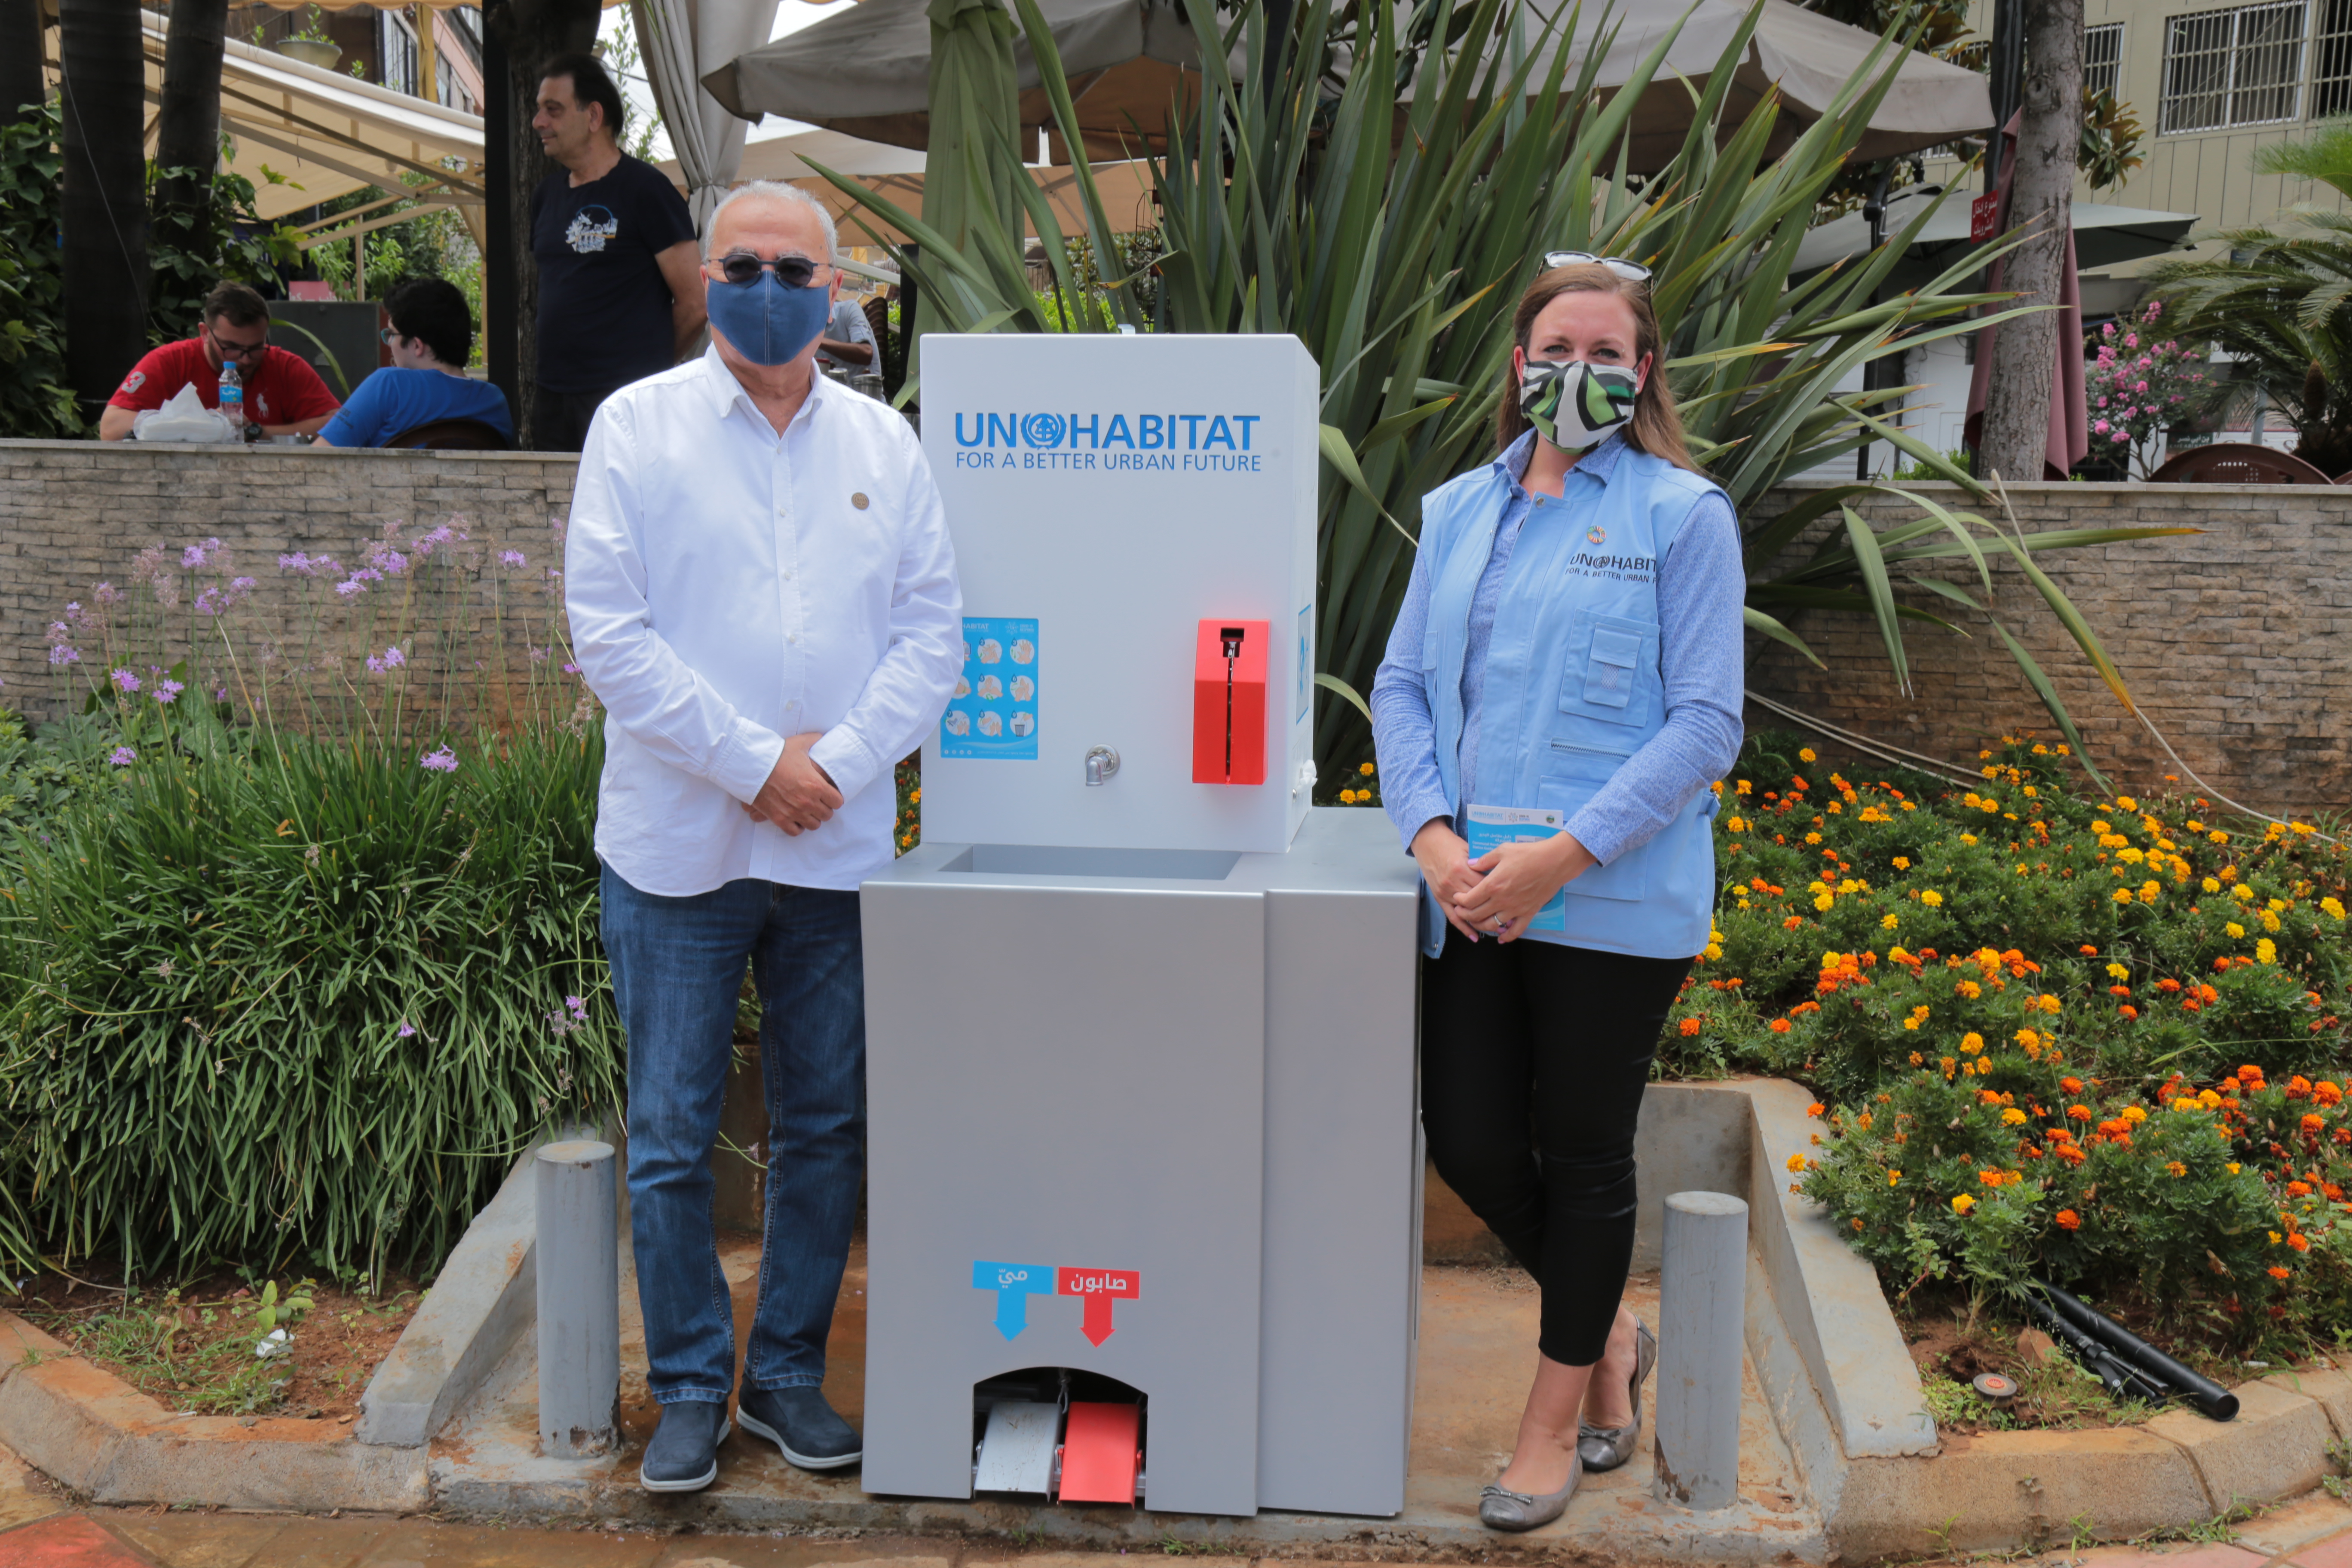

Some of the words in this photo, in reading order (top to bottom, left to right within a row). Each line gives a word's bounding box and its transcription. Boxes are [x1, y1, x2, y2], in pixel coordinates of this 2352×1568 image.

[122, 371, 146, 393] 3
[956, 452, 995, 469] FOR
[1001, 452, 1016, 469] A
[1024, 453, 1096, 469] BETTER
[1104, 453, 1175, 470] URBAN
[1183, 454, 1261, 472] FUTURE
[1592, 570, 1621, 581] BETTER
[1623, 573, 1650, 583] URBAN
[1071, 1273, 1127, 1294] صابون
